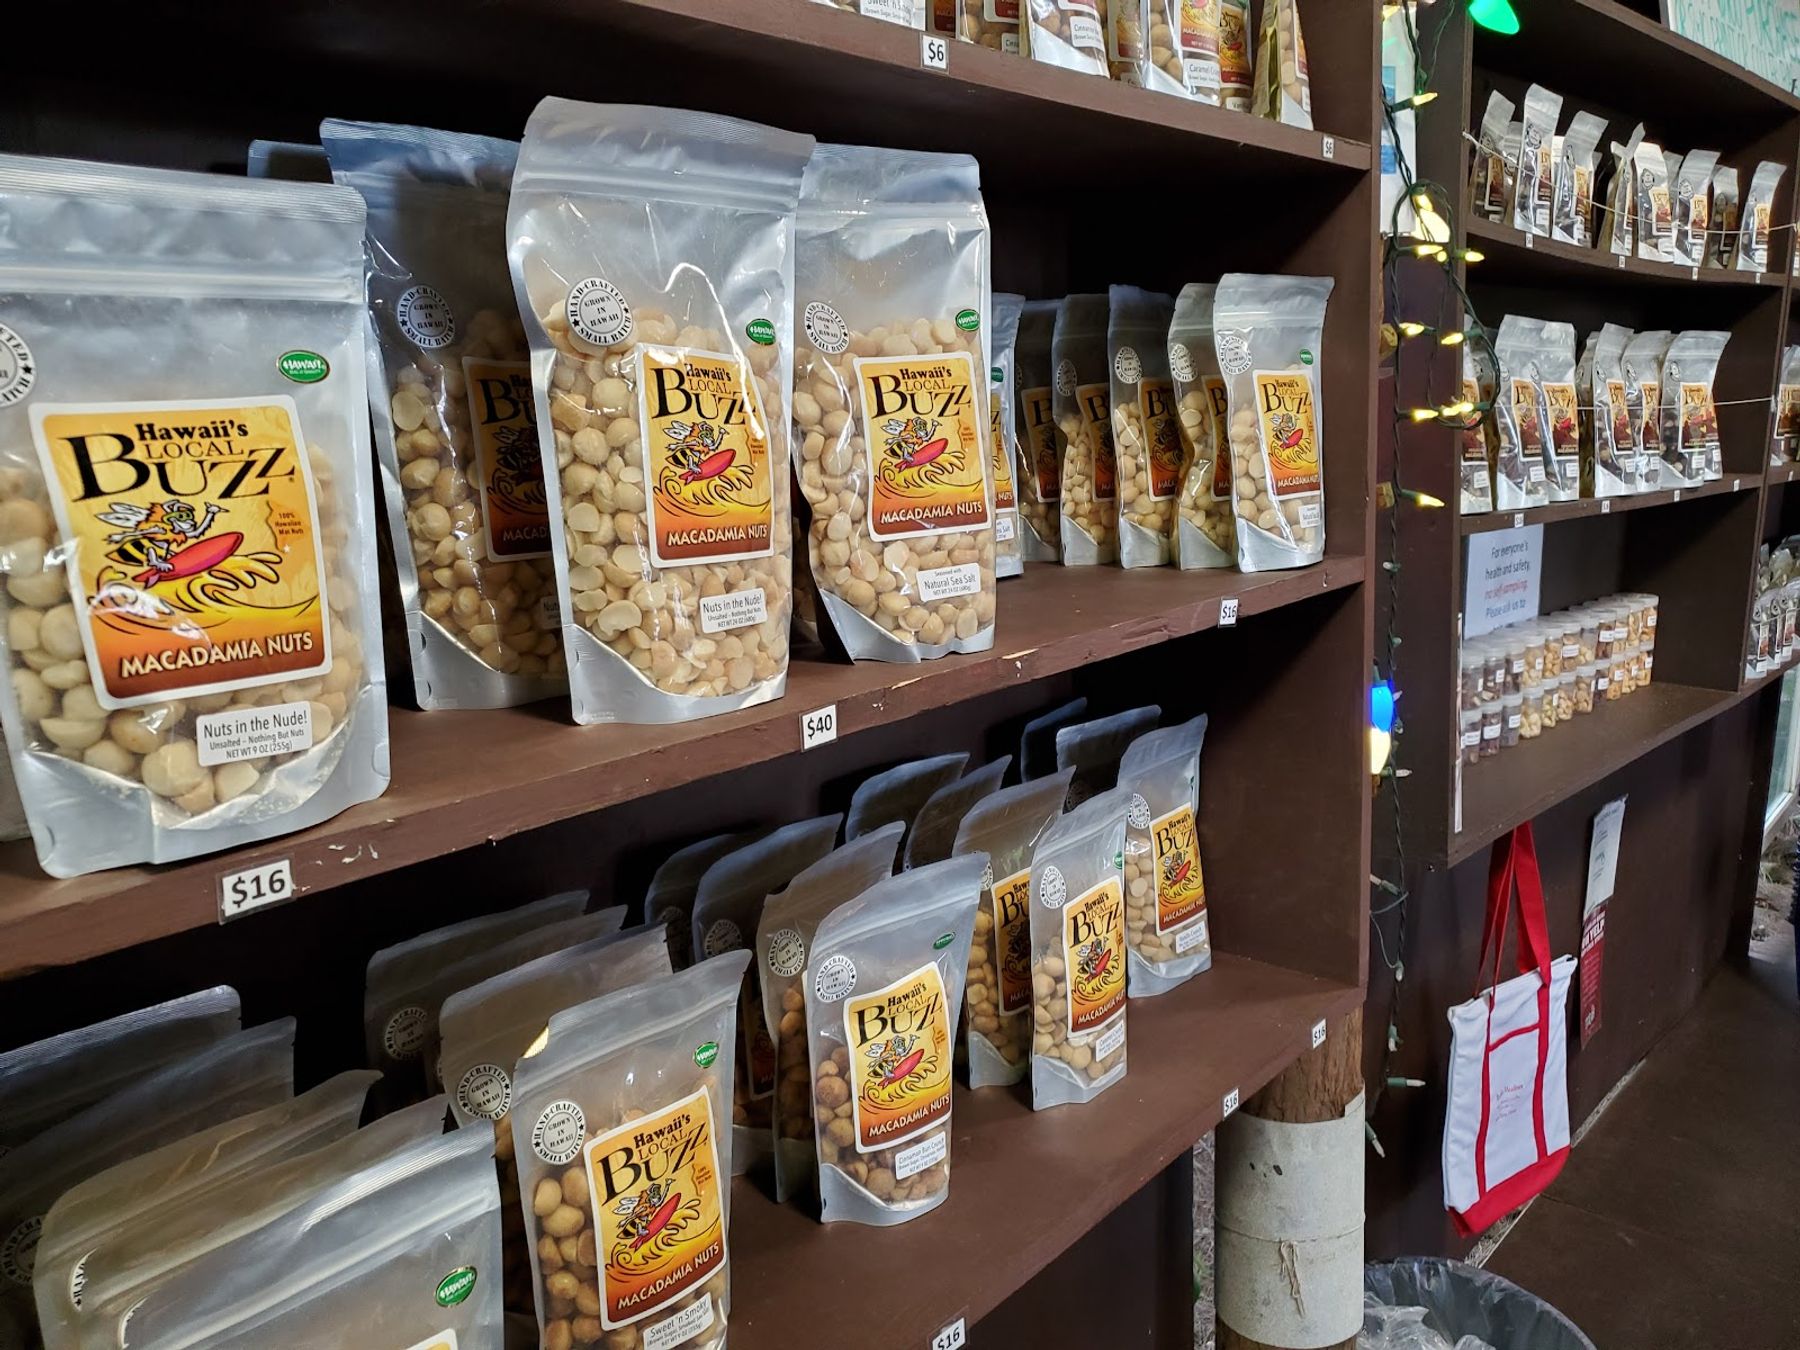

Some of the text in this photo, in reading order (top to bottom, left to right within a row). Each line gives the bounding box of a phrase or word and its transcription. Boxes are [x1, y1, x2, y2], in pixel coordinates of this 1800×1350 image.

[928, 42, 944, 63] $6
[597, 306, 606, 315] IN
[578, 327, 609, 344] SMALL
[684, 363, 732, 382] Hawaii's
[898, 365, 953, 381] Hawaii's
[650, 366, 757, 426] BUZZ
[688, 379, 732, 395] LOCAL
[903, 377, 950, 392] LOCAL
[868, 374, 972, 420] BUZZ
[1260, 382, 1312, 415] BUZZ
[136, 420, 248, 442] Hawaii's
[144, 439, 246, 460] LOCAL
[57, 432, 296, 503] BUZZ
[880, 500, 983, 525] MACADAMIA NUTS
[666, 523, 768, 547] MACADAMIA NUTS
[924, 577, 950, 590] Natural
[950, 575, 964, 586] Sea
[703, 601, 723, 614] Nuts
[723, 599, 732, 611] in
[732, 597, 744, 609] the
[1221, 604, 1237, 620] $16
[120, 631, 314, 679] MACADAMIA NUTS
[203, 709, 309, 739] Nuts in the Nude!
[807, 713, 833, 741] $40
[209, 728, 305, 751] Unsalted Nothing But Nuts
[226, 748, 239, 760] NET
[240, 746, 251, 757] WT
[259, 743, 269, 753] OZ
[230, 867, 286, 910] $16
[1070, 901, 1123, 949] BUZZ
[886, 981, 928, 1009] Hawaii's
[888, 996, 929, 1017] LOCAL
[855, 991, 944, 1049] BUZZ
[1313, 1025, 1326, 1044] $16
[482, 1088, 490, 1097] IN
[1225, 1093, 1238, 1114] $16
[534, 1103, 583, 1140] HAND-CRAFTED
[869, 1094, 951, 1138] MACADAMIA NUTS
[633, 1114, 691, 1149] Hawaii's
[539, 1148, 563, 1162] SMALL
[638, 1129, 688, 1161] LOCAL
[596, 1121, 709, 1207] BUZZ
[616, 1242, 720, 1311] MACADAMIA NUTS
[650, 1319, 674, 1338] Sweet
[937, 1326, 960, 1350] $16
